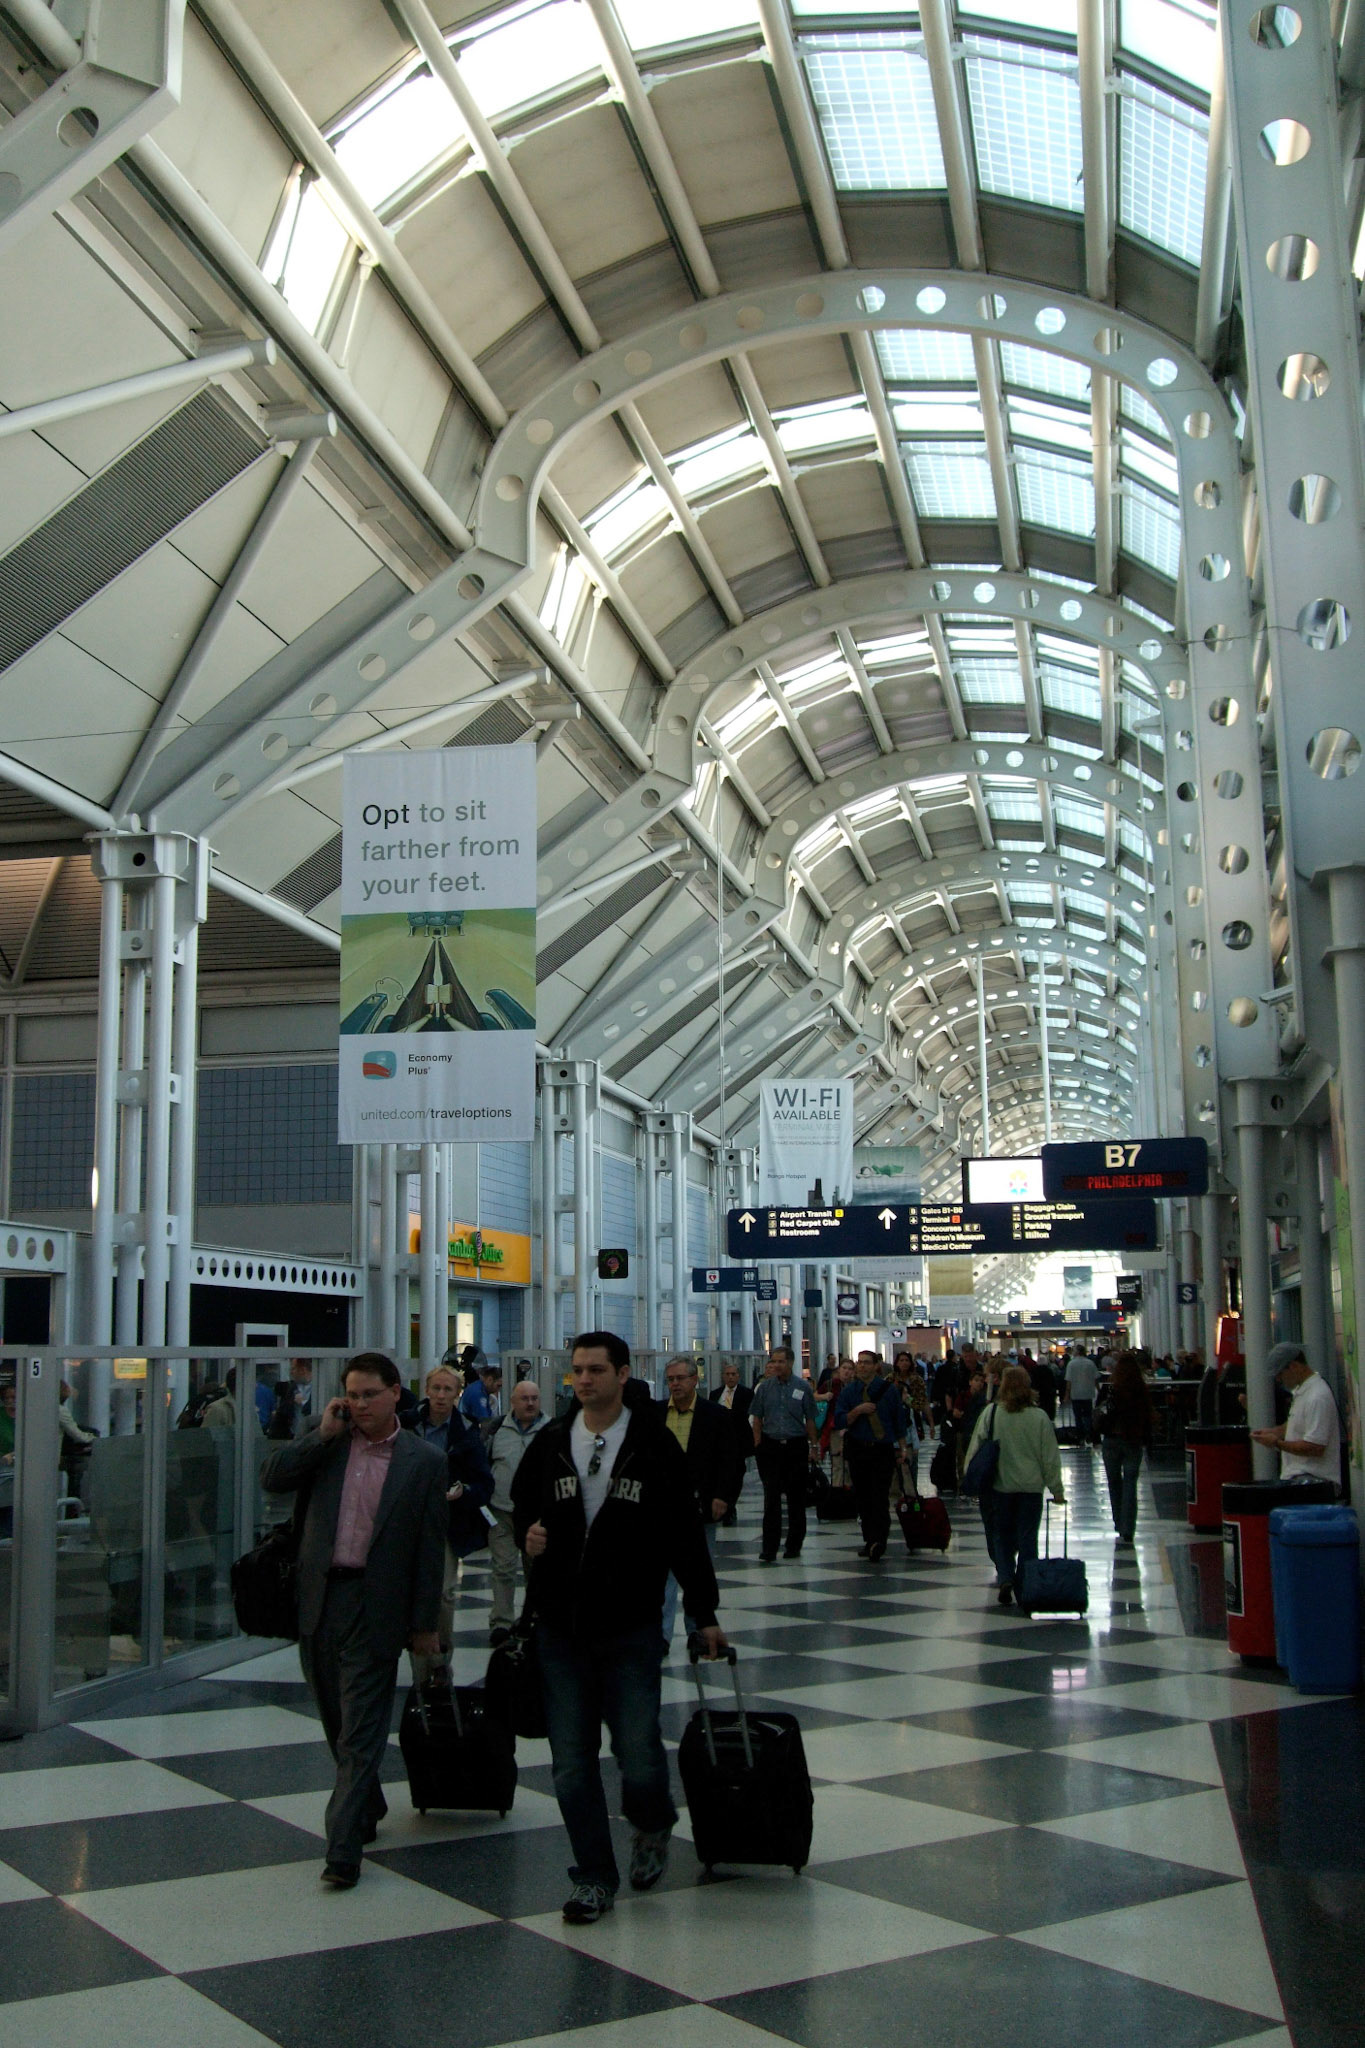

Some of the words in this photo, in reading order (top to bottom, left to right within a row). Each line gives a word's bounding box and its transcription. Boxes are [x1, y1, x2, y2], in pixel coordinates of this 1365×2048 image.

[362, 804, 410, 830] Opt
[419, 803, 445, 823] to
[455, 799, 487, 822] sit
[361, 838, 450, 861] farther
[459, 836, 520, 857] from
[362, 877, 420, 901] your
[428, 871, 486, 893] feet.
[408, 1053, 453, 1063] Economy
[773, 1087, 841, 1107] WI-FI
[772, 1110, 841, 1120] AVAILABLE
[1105, 1144, 1142, 1168] B7
[1088, 1173, 1162, 1189] PHILADELPHIA
[1024, 1204, 1055, 1212] Baggage
[780, 1211, 806, 1220] Airport
[807, 1210, 832, 1218] Transit
[1024, 1213, 1050, 1221] Ground
[1050, 1212, 1085, 1221] Transport
[796, 1220, 821, 1228] Carpet
[921, 1225, 962, 1233] Concourses
[1024, 1222, 1051, 1231] Parking
[956, 1233, 985, 1241] Museum
[1025, 1231, 1050, 1239] Hilton
[448, 1238, 473, 1258] amba
[32, 1361, 40, 1376] 5
